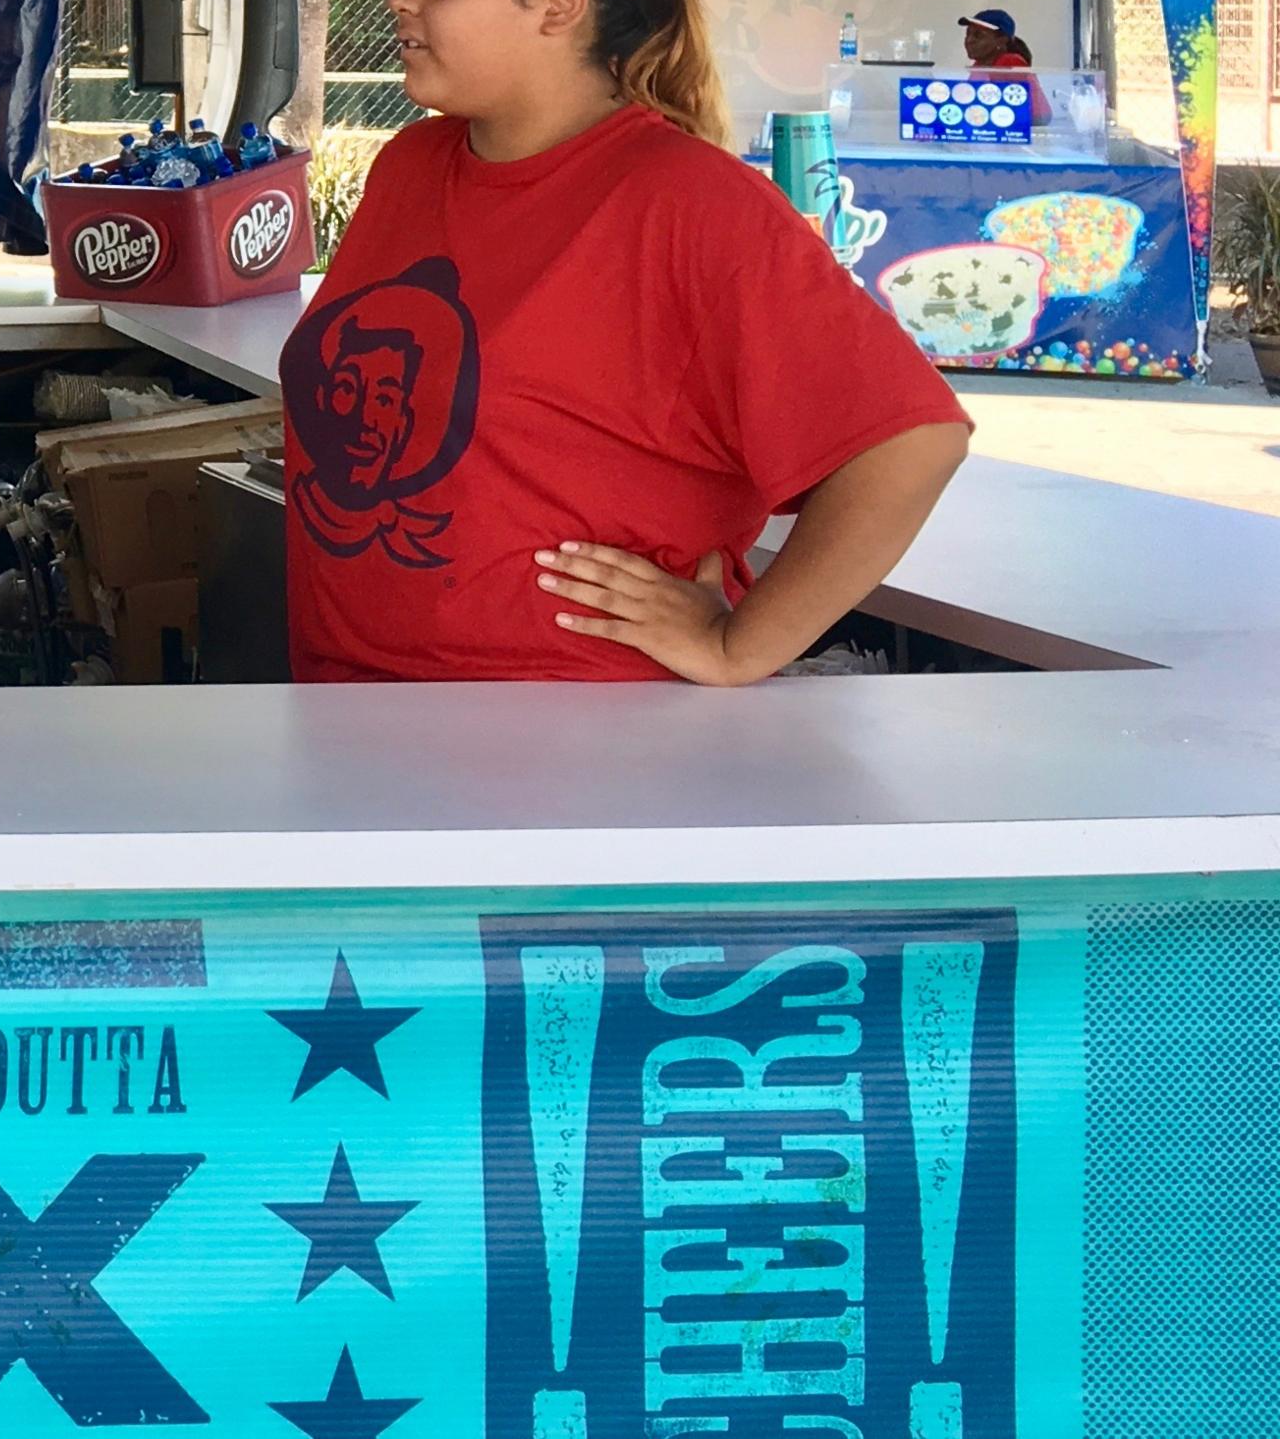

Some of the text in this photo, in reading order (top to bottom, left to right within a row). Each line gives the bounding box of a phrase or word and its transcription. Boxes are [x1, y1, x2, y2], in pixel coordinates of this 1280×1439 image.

[101, 221, 130, 244] Dr
[235, 203, 289, 268] Pepper
[251, 200, 273, 230] Dr
[76, 226, 153, 275] Pepper
[641, 945, 867, 1439] HEERS
